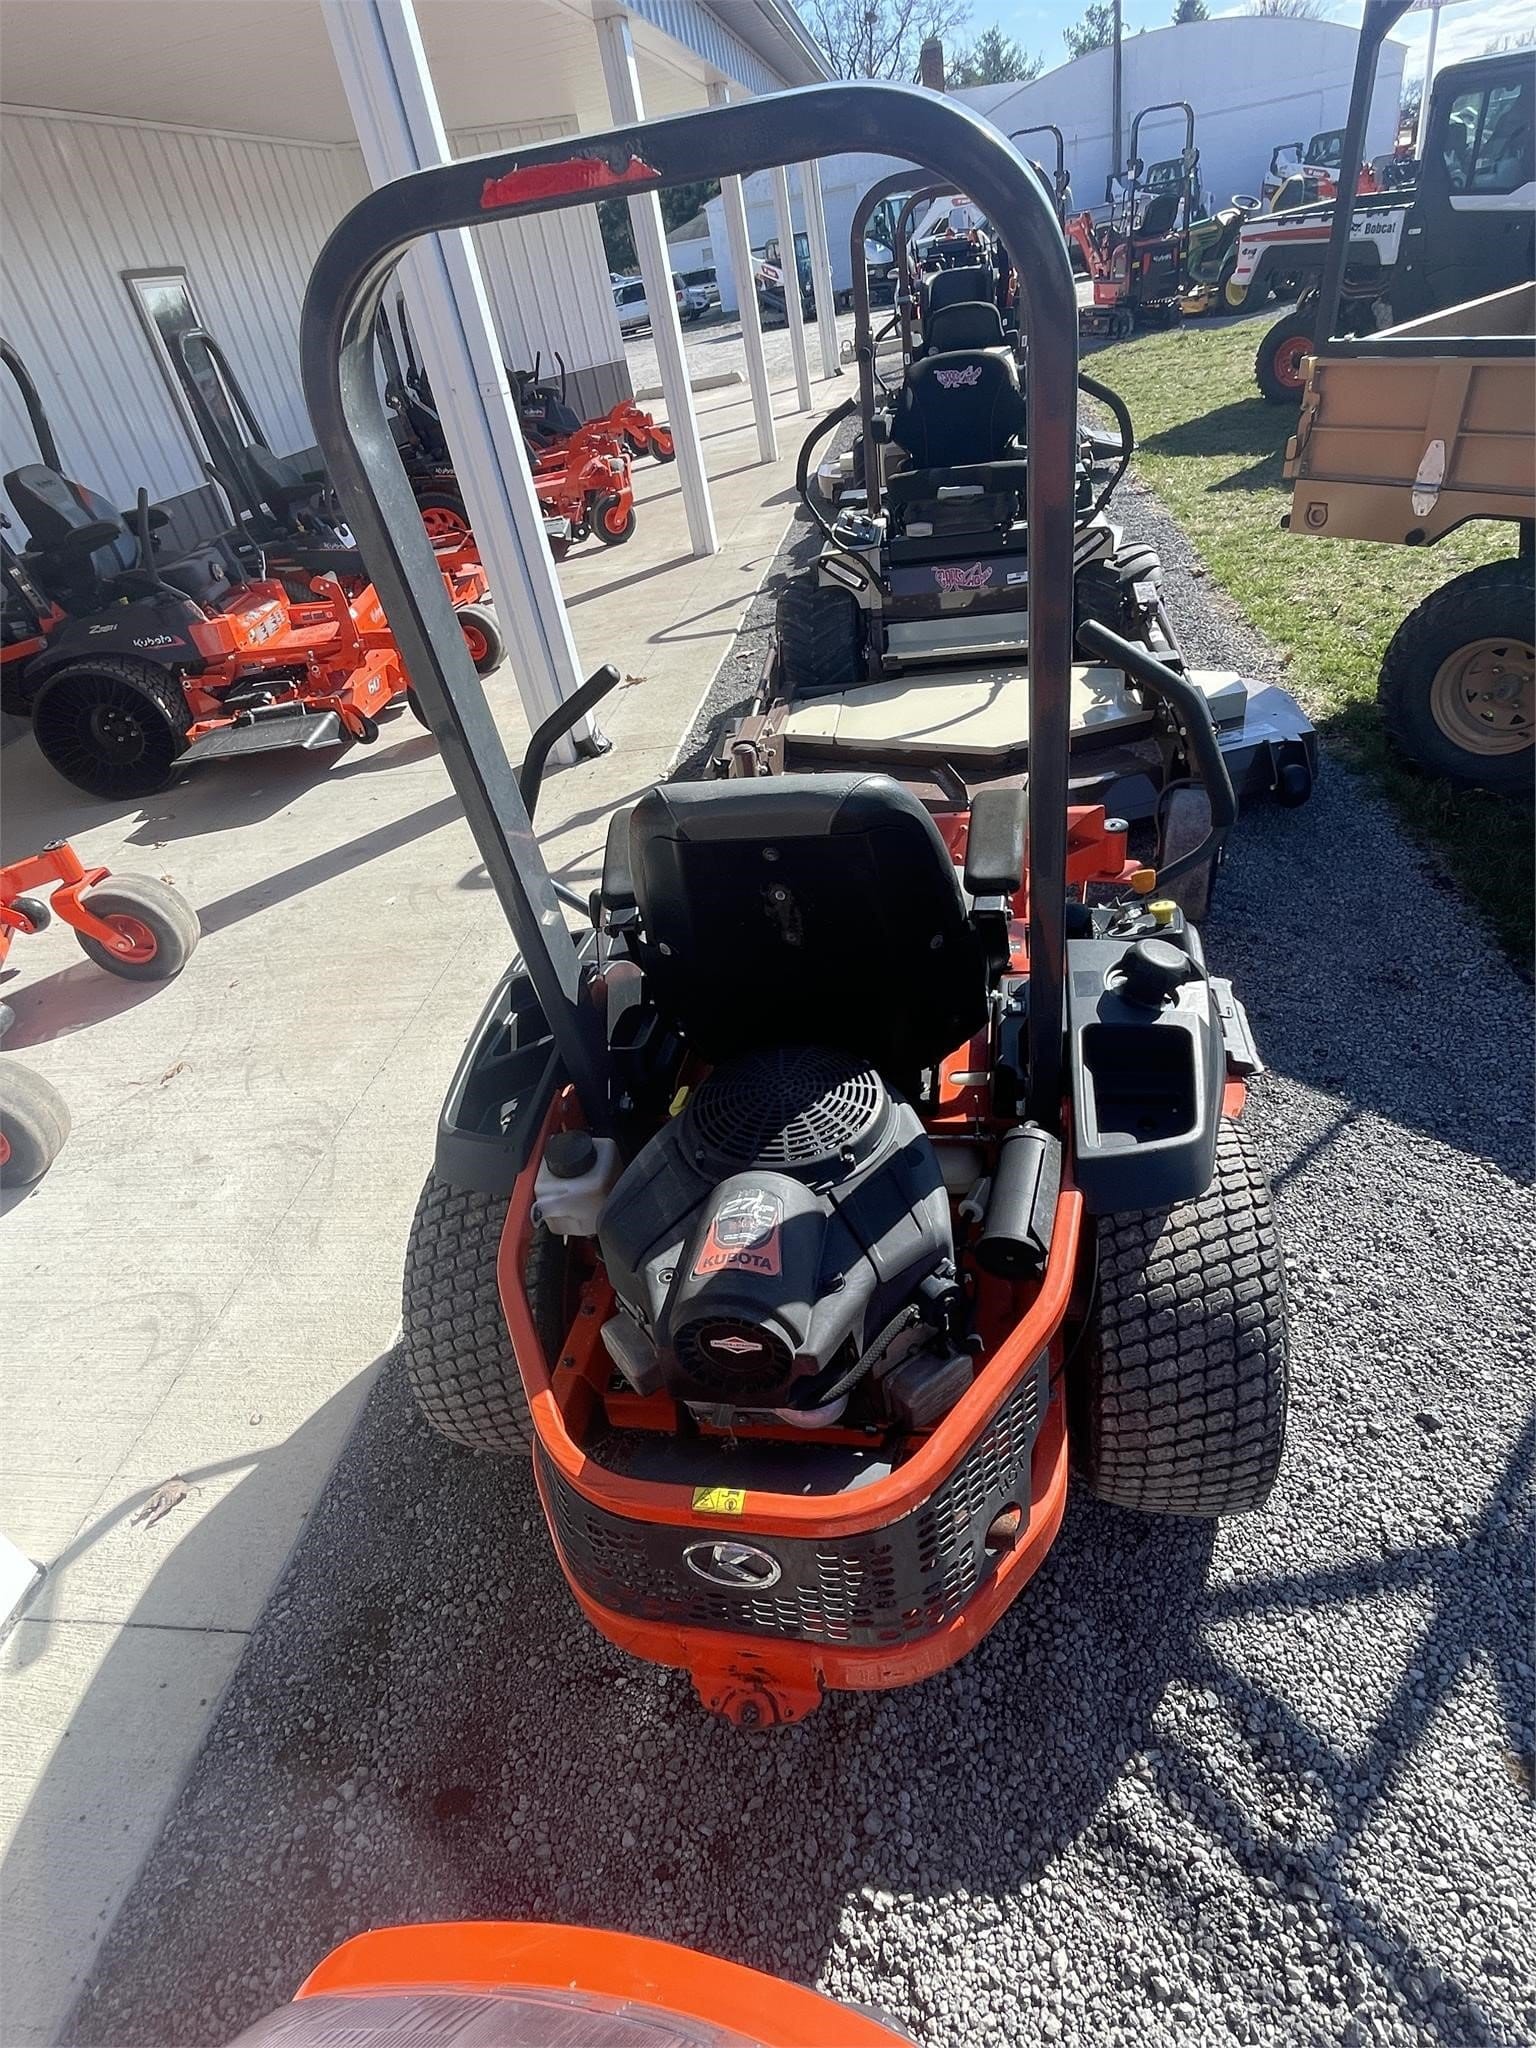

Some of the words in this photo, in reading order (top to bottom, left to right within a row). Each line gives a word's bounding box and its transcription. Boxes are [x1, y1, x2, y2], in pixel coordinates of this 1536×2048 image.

[1364, 223, 1396, 235] Bobcat
[133, 635, 173, 648] Kubota
[703, 1252, 772, 1271] KUBOTA
[998, 1454, 1024, 1500] HOT
